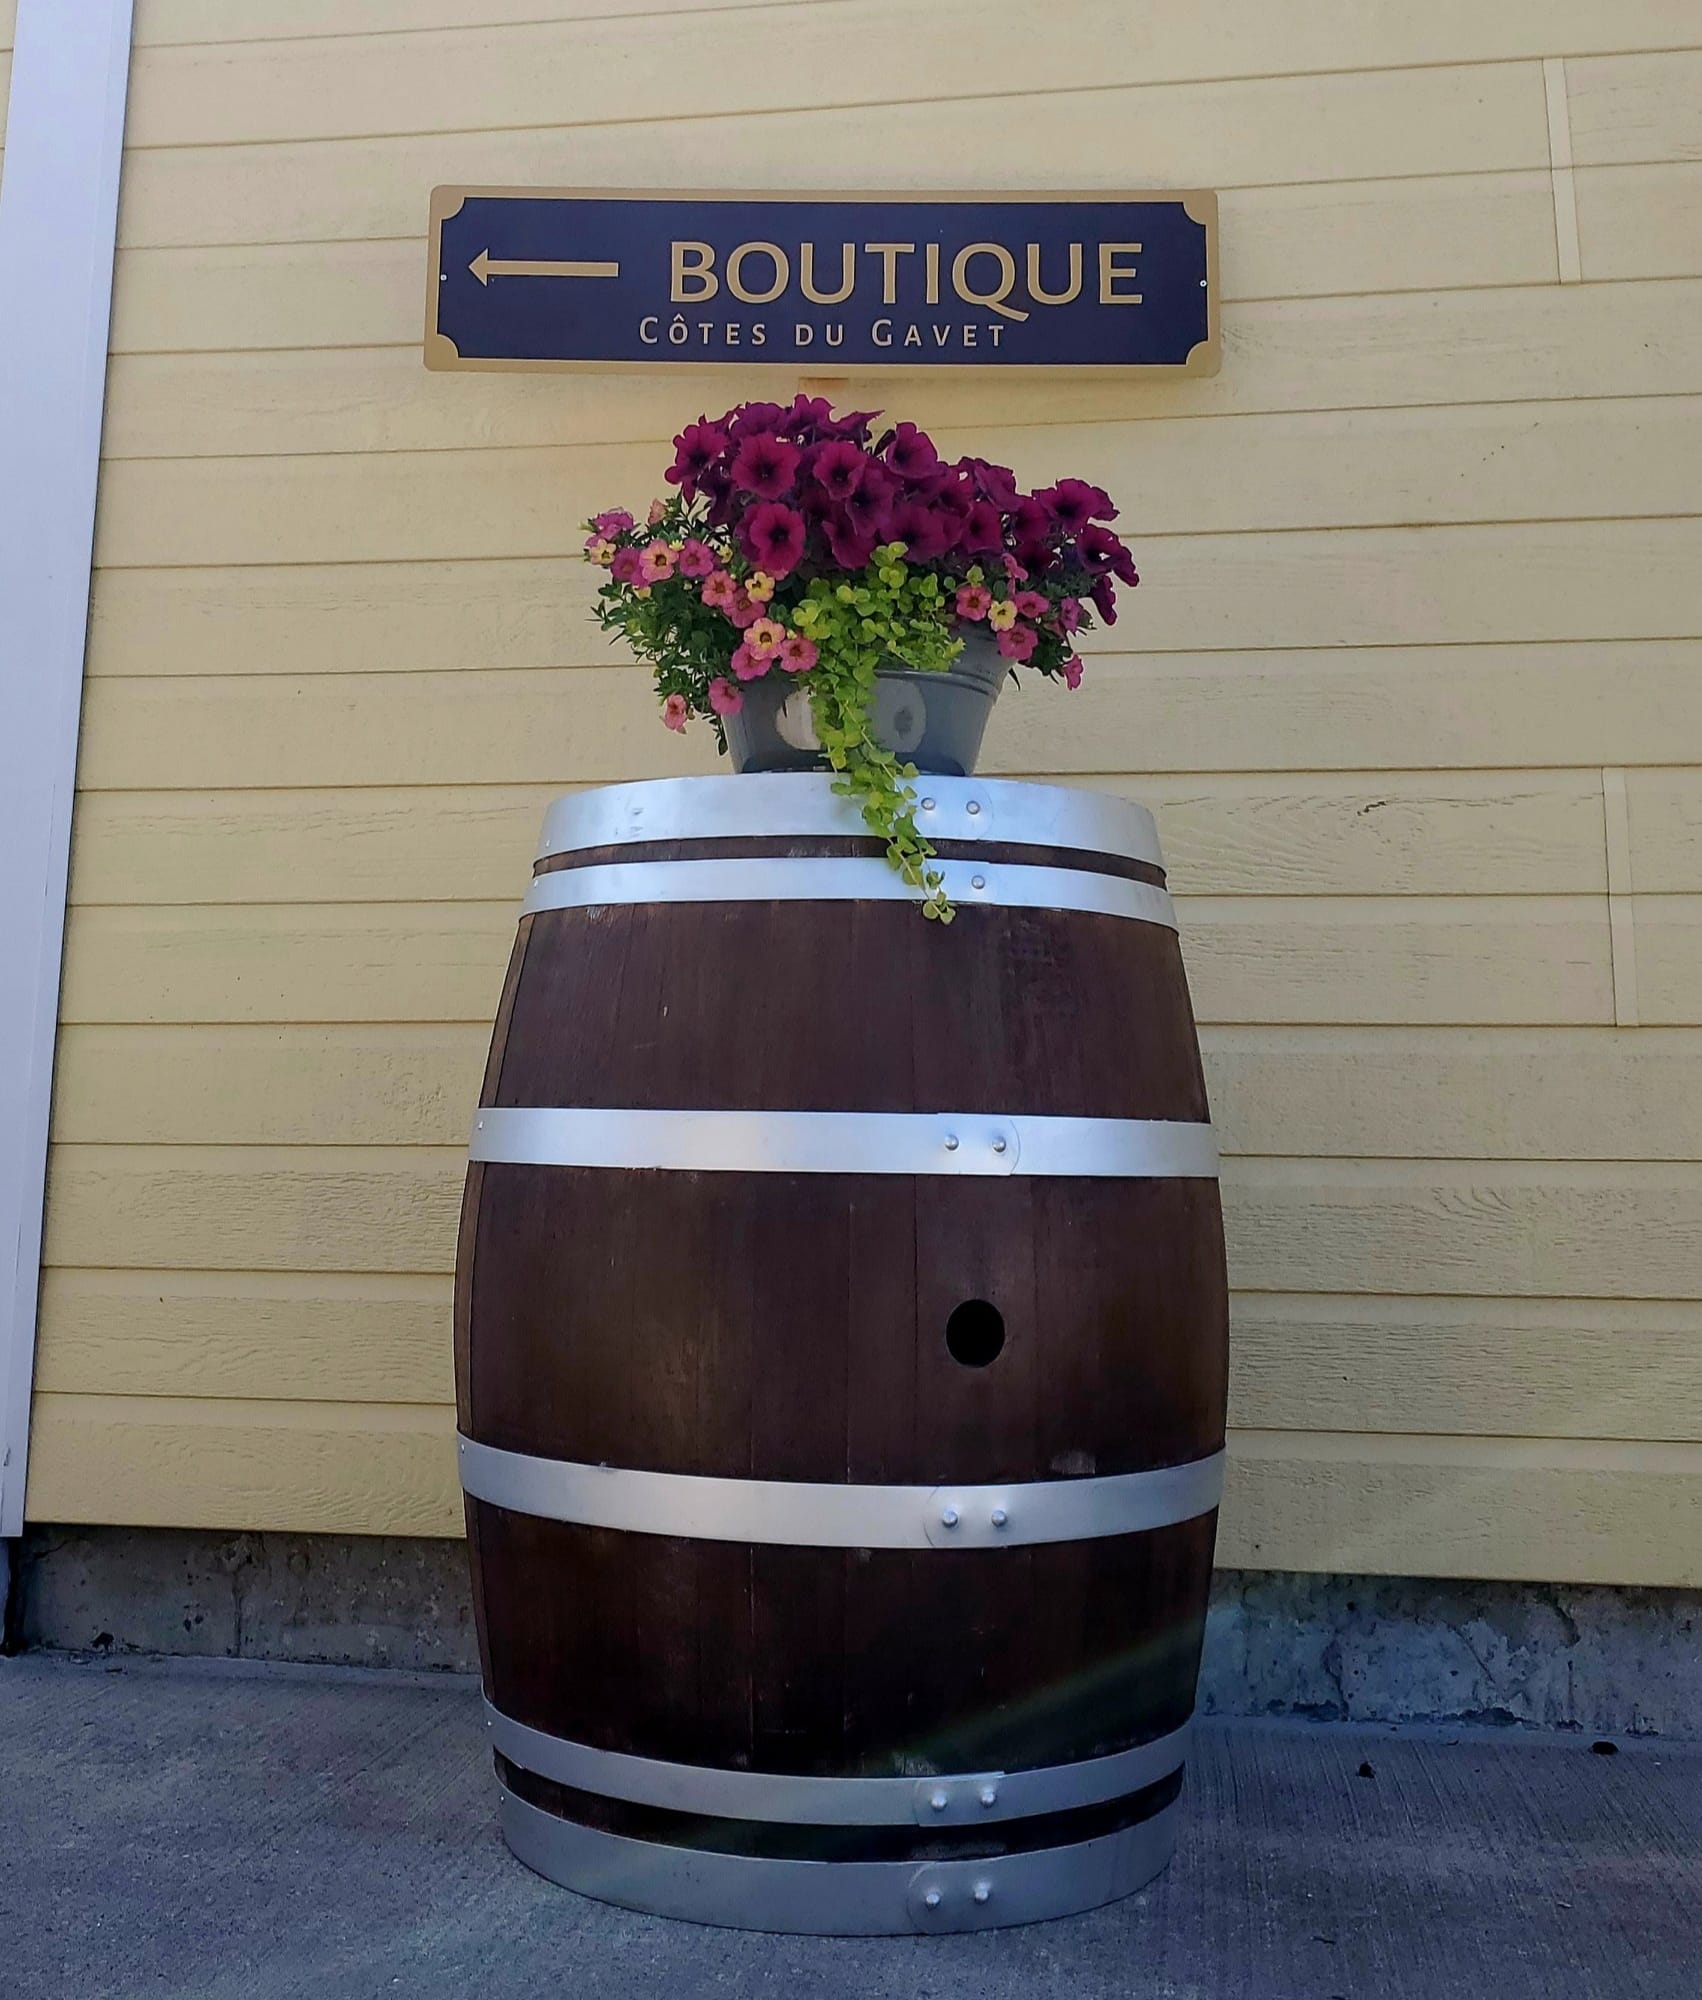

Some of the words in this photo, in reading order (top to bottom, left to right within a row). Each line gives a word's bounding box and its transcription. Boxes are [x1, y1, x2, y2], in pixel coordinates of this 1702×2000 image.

[669, 240, 1144, 322] BOUTIQUE
[638, 313, 767, 346] CÔTES
[795, 323, 844, 347] DU
[871, 318, 1007, 348] GAVET
